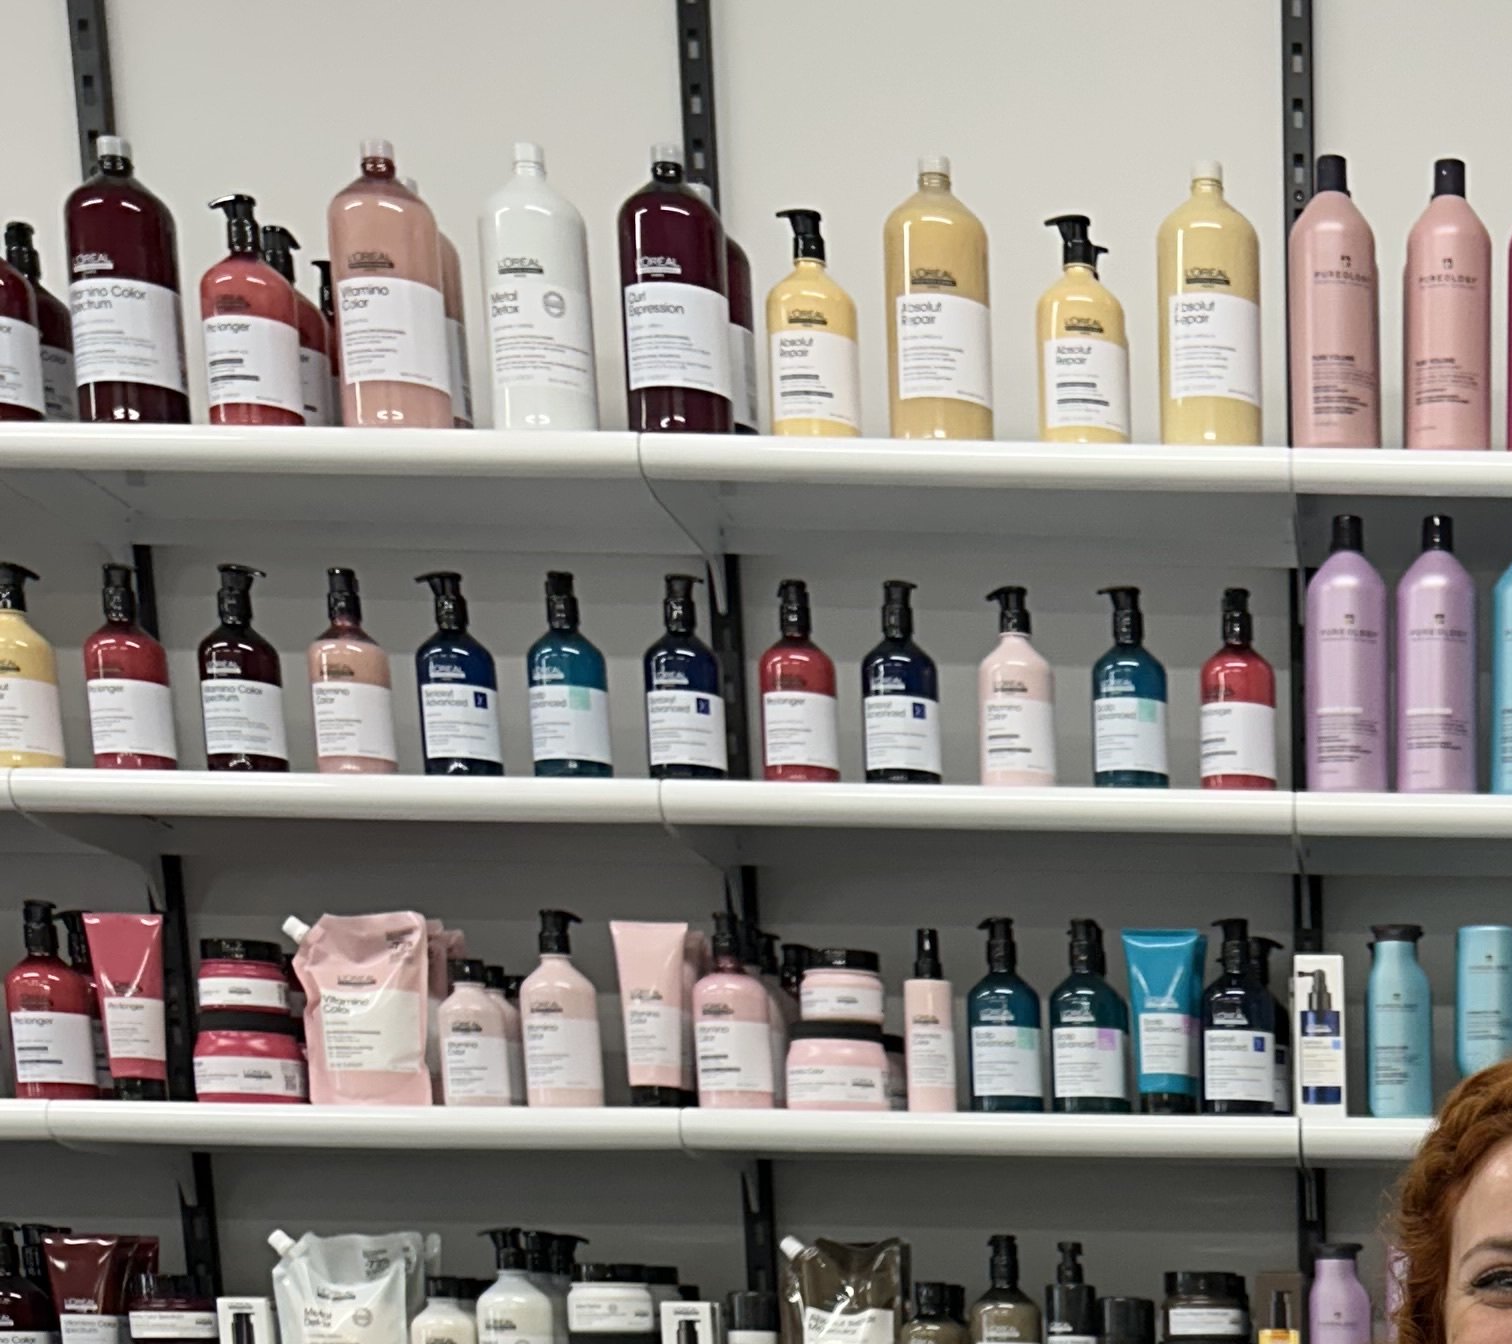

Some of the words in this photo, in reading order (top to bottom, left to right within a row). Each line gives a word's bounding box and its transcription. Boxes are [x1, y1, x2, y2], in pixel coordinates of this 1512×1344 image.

[1313, 271, 1371, 283] PUREOLOGY
[1419, 276, 1478, 285] PUREOLOGY
[111, 285, 147, 301] Color
[341, 285, 389, 297] Vitamino
[342, 300, 368, 310] Color
[491, 304, 519, 317] Detox
[628, 304, 685, 316] Expression
[779, 337, 813, 347] Absolut
[1056, 345, 1092, 355] Absolut
